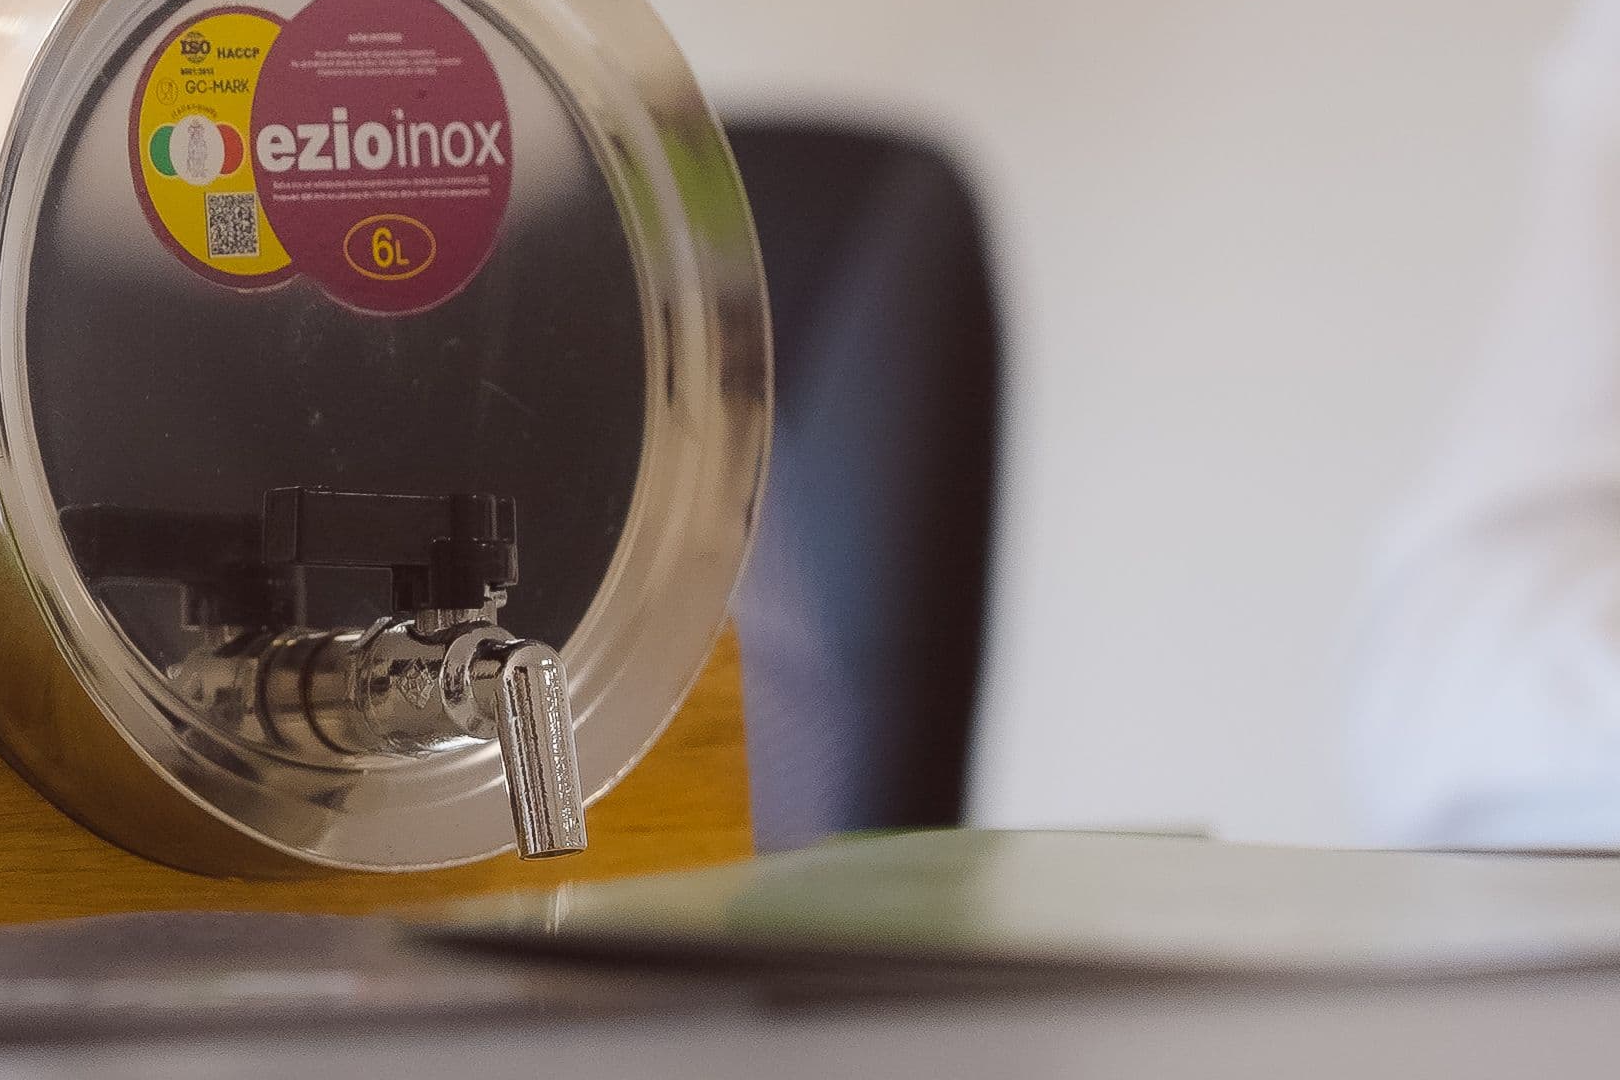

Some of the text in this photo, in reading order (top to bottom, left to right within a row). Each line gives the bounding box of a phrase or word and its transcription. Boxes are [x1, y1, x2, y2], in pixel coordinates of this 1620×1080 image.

[180, 40, 211, 55] ISO
[217, 47, 260, 59] HACCP
[185, 79, 250, 94] GC-MARK
[256, 107, 505, 172] ezioinox
[372, 227, 410, 268] 6L
